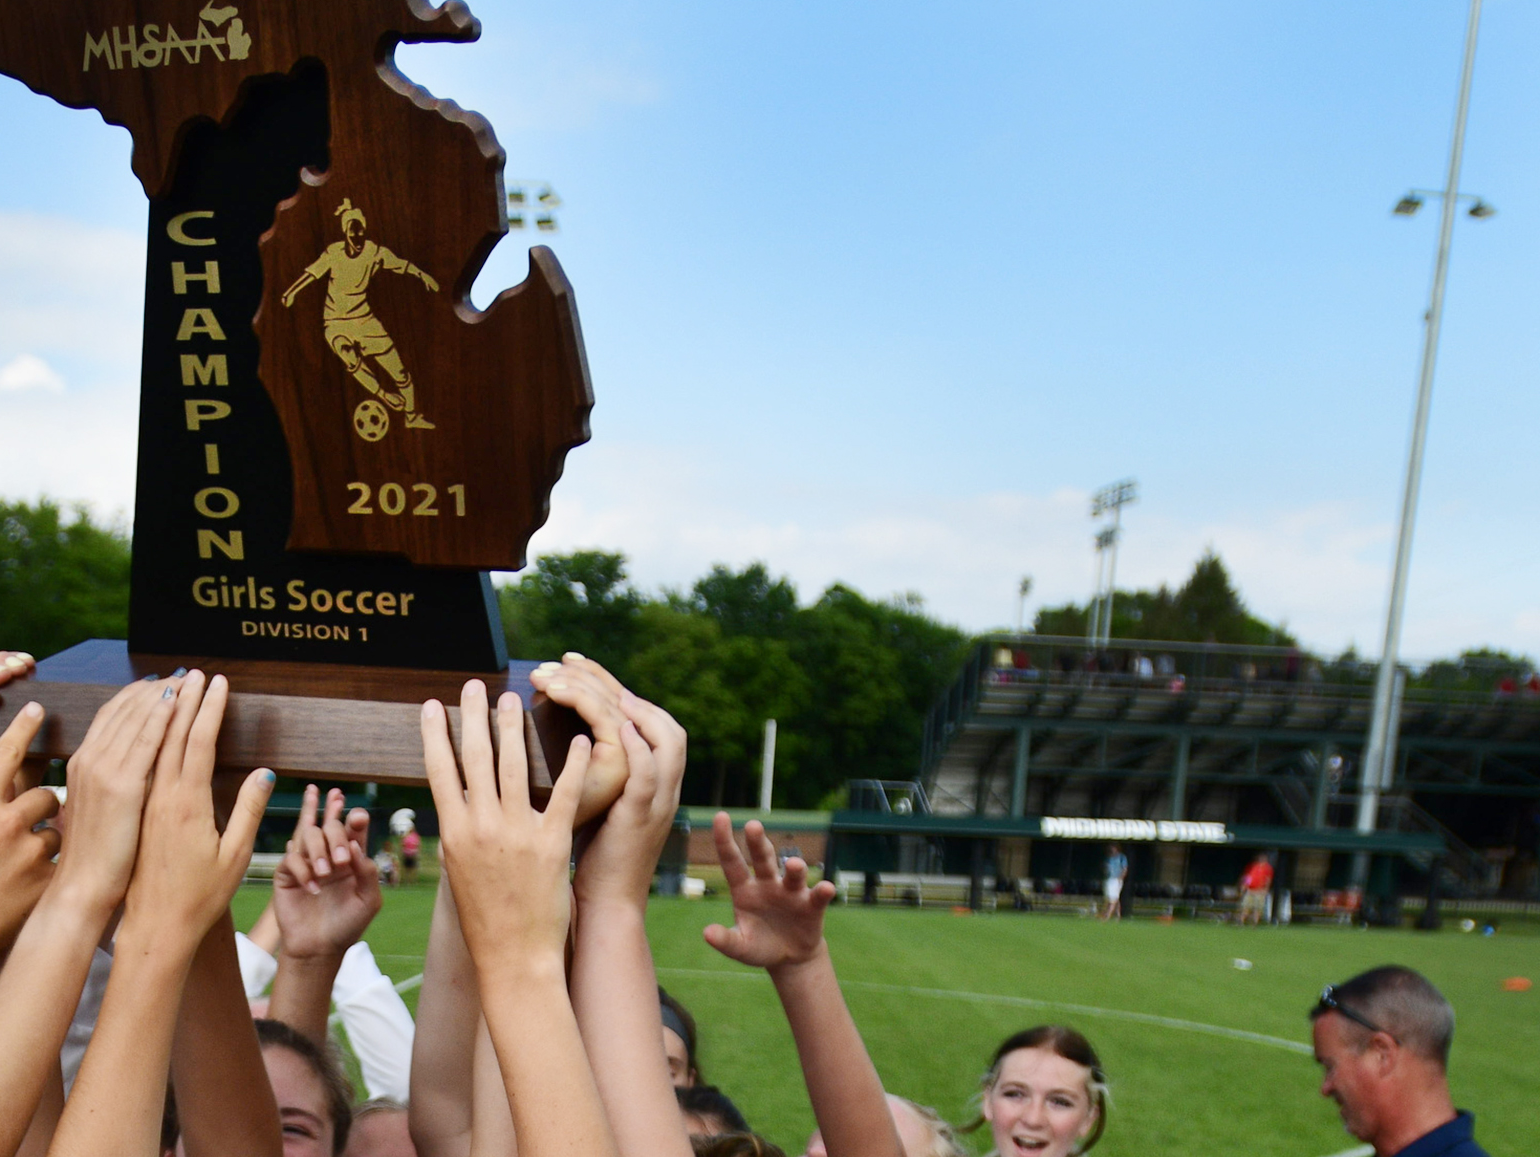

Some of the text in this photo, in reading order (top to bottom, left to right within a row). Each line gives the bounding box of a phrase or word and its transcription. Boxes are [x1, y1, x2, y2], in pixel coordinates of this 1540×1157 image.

[82, 20, 226, 72] MHSAA
[166, 210, 244, 561] CHAMPION
[346, 482, 466, 517] 2021
[192, 575, 415, 616] Girls Soccer
[241, 620, 369, 642] DIVISION 1
